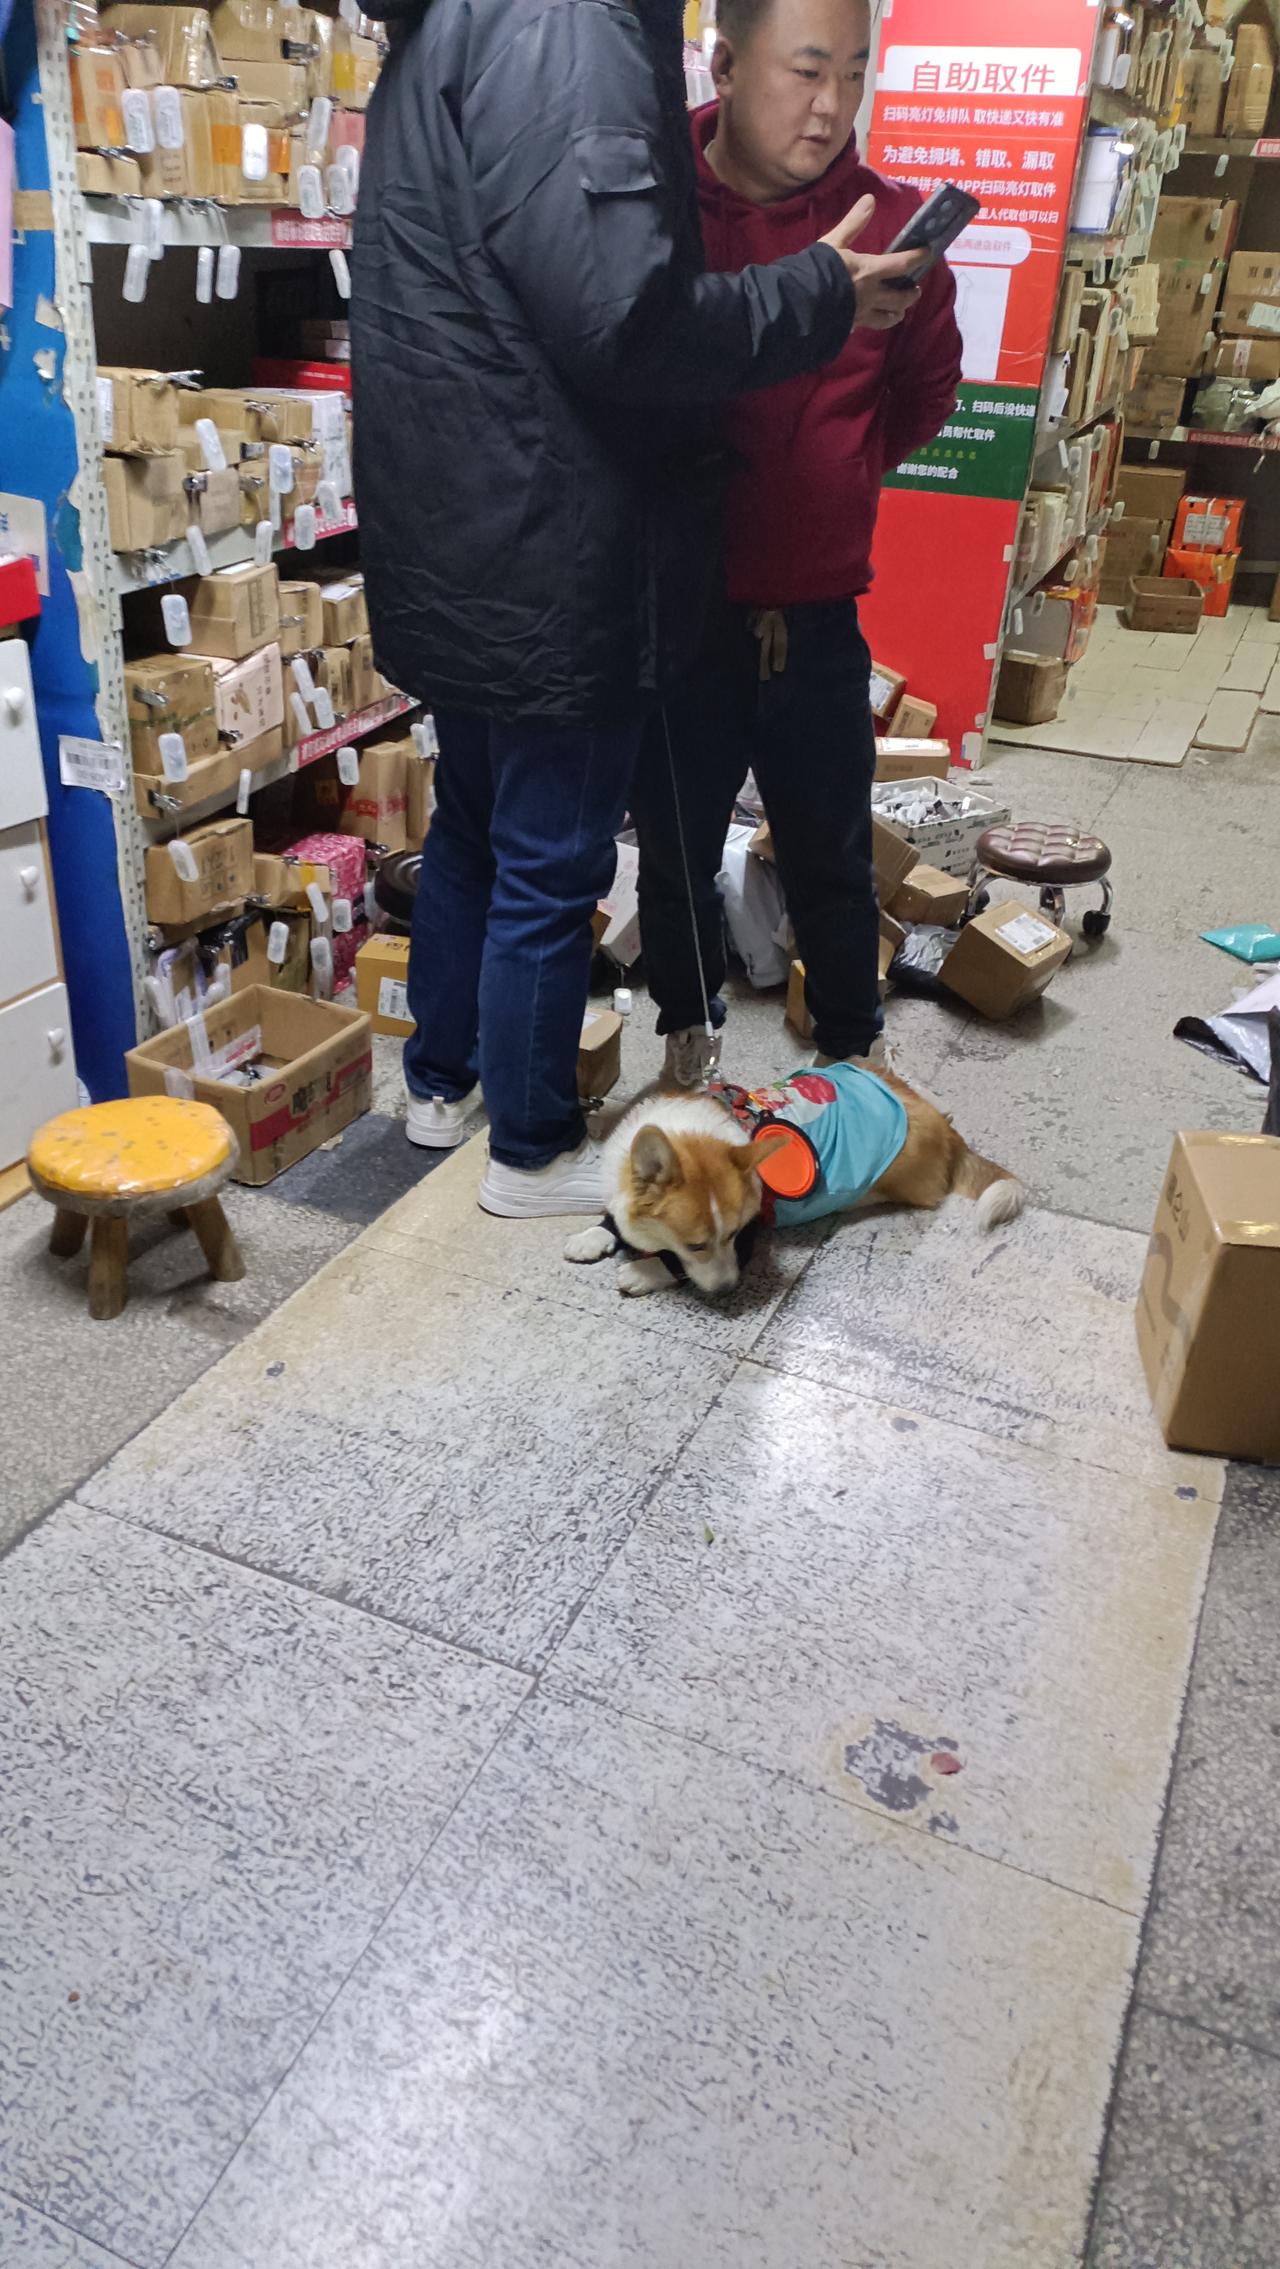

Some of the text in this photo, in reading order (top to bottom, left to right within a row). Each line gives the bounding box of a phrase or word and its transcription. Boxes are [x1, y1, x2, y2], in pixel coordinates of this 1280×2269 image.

[913, 61, 1055, 93] 自助取件
[883, 105, 1064, 127] 扫码亮灯免排队 取快递又快有准
[974, 207, 1059, 224] 里人代取也可以扫
[937, 425, 996, 442] 员帮忙取件
[896, 462, 959, 480] 谢谢您的配合
